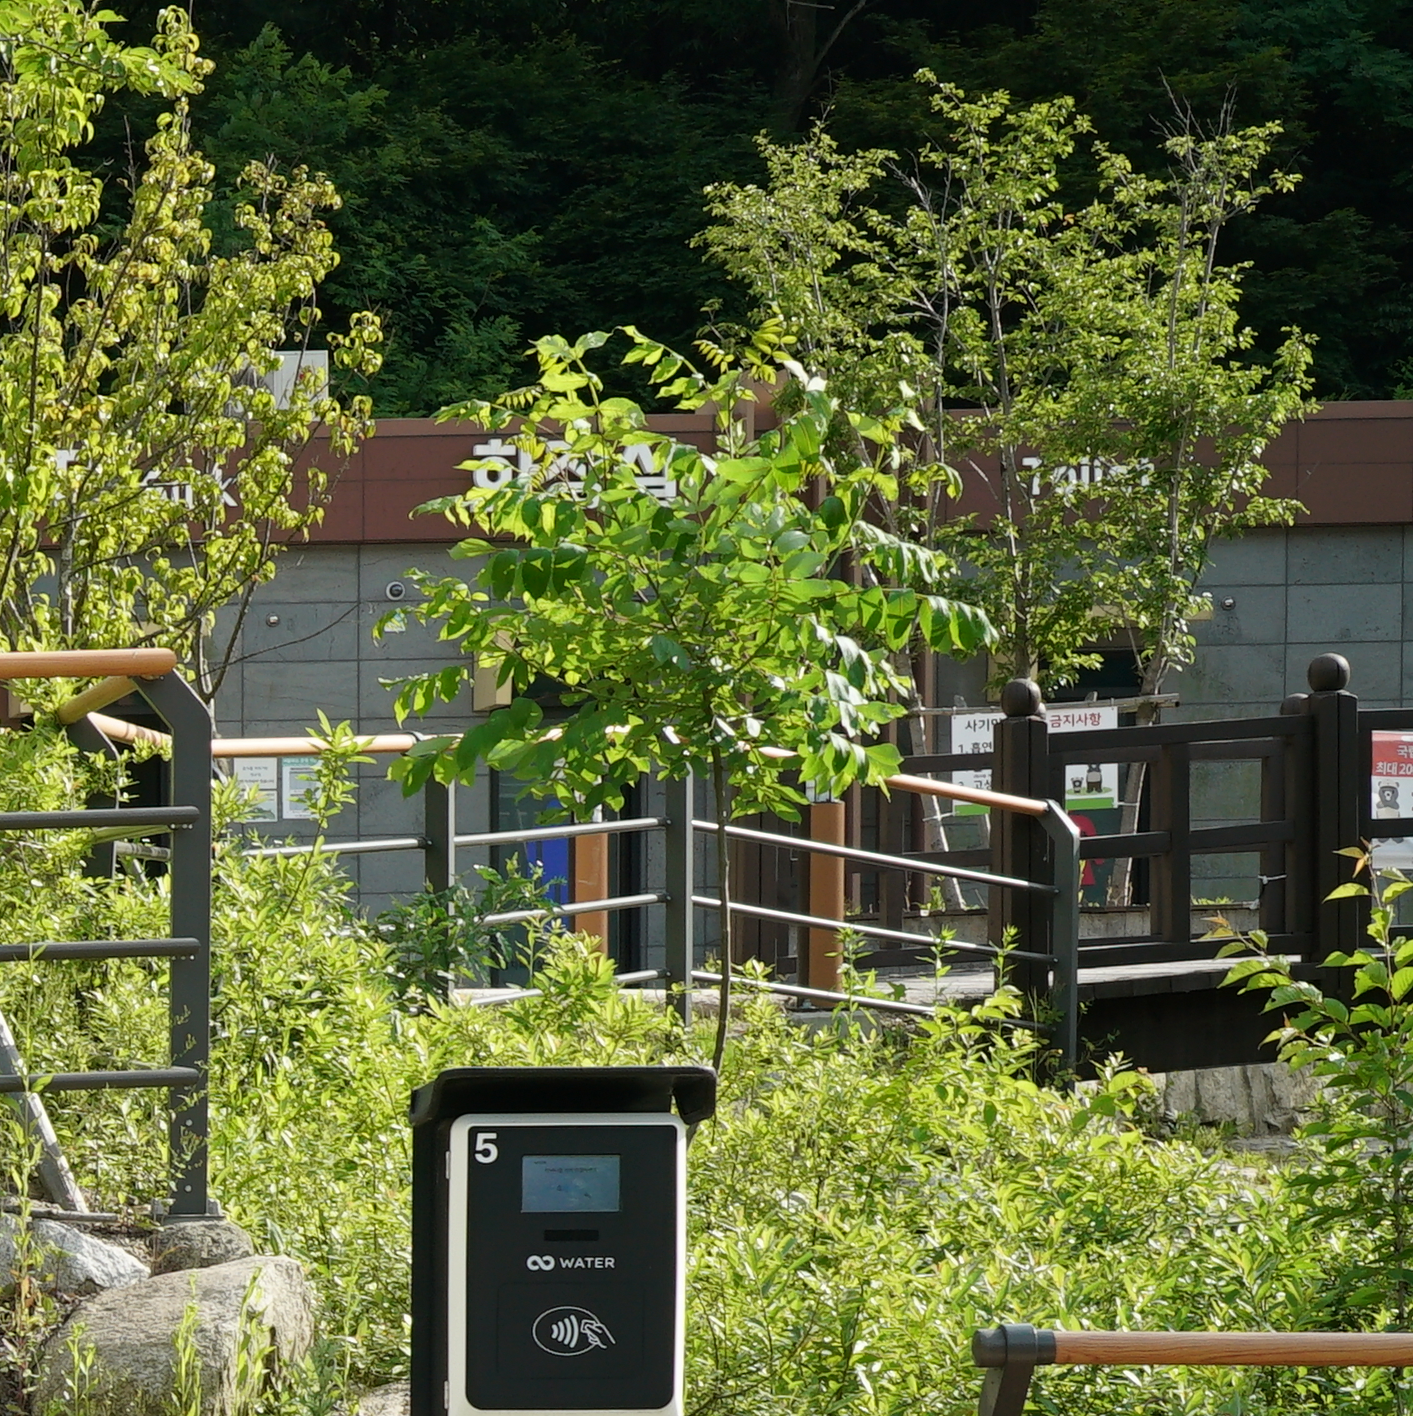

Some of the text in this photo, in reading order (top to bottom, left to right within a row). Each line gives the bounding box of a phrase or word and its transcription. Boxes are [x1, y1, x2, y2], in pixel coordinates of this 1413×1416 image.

[1049, 712, 1102, 728] 금지사항
[1375, 760, 1413, 775] 최대 20
[475, 1132, 499, 1164] 5
[559, 1257, 615, 1269] WATER
